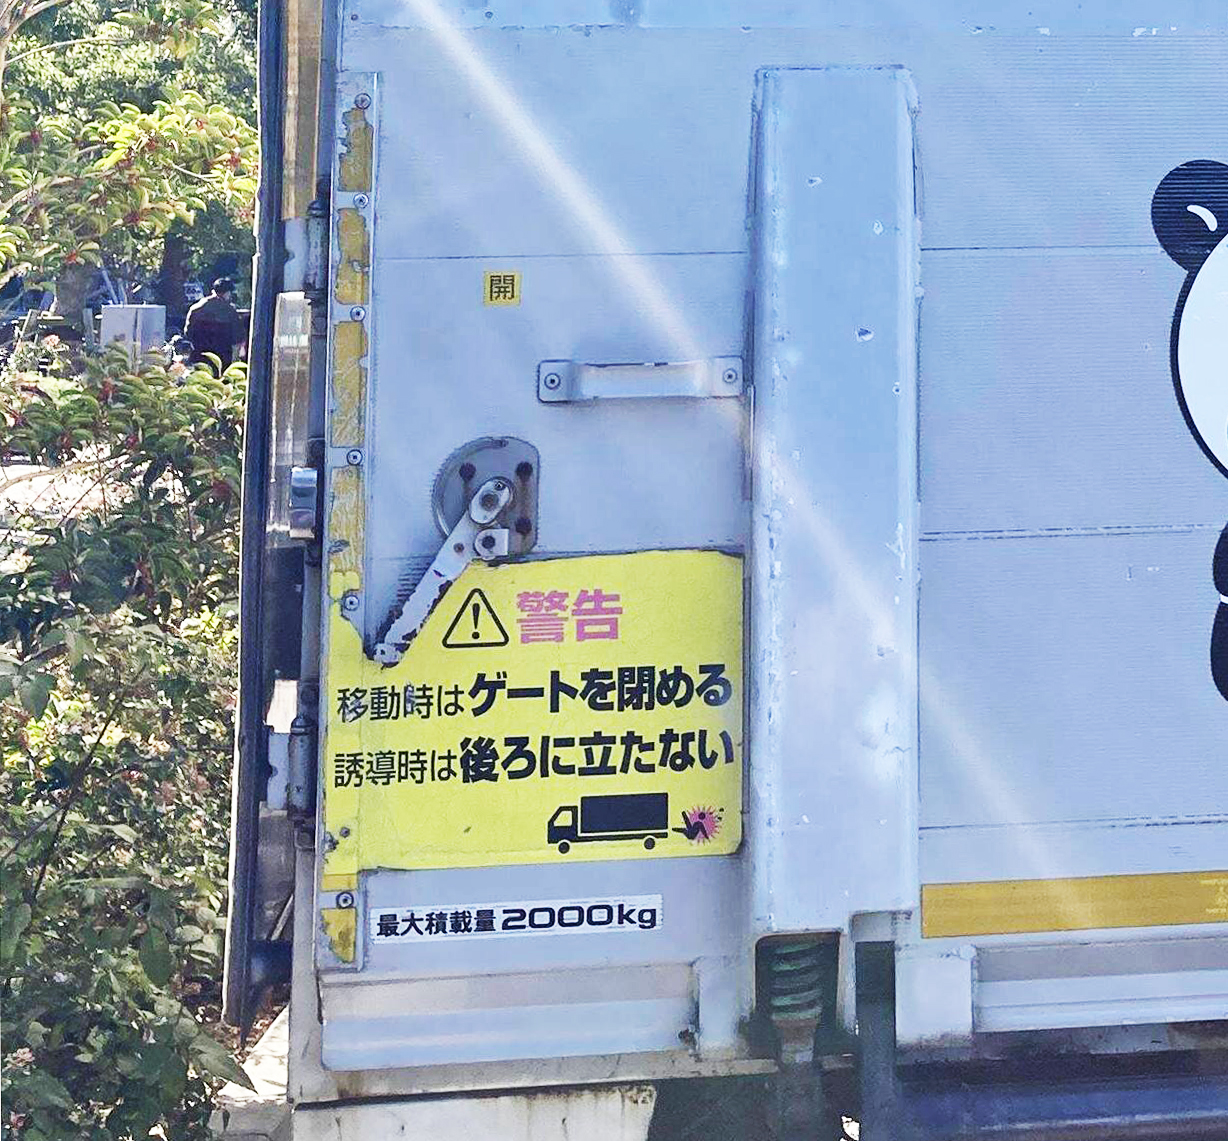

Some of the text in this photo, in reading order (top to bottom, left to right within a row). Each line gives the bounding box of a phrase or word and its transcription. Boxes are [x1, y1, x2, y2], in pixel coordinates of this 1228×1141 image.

[489, 274, 516, 302] 開
[516, 588, 624, 645] 警告
[337, 663, 733, 724] 移動時はゲートを閉める
[333, 728, 735, 789] 誘導時は後ろに立たない
